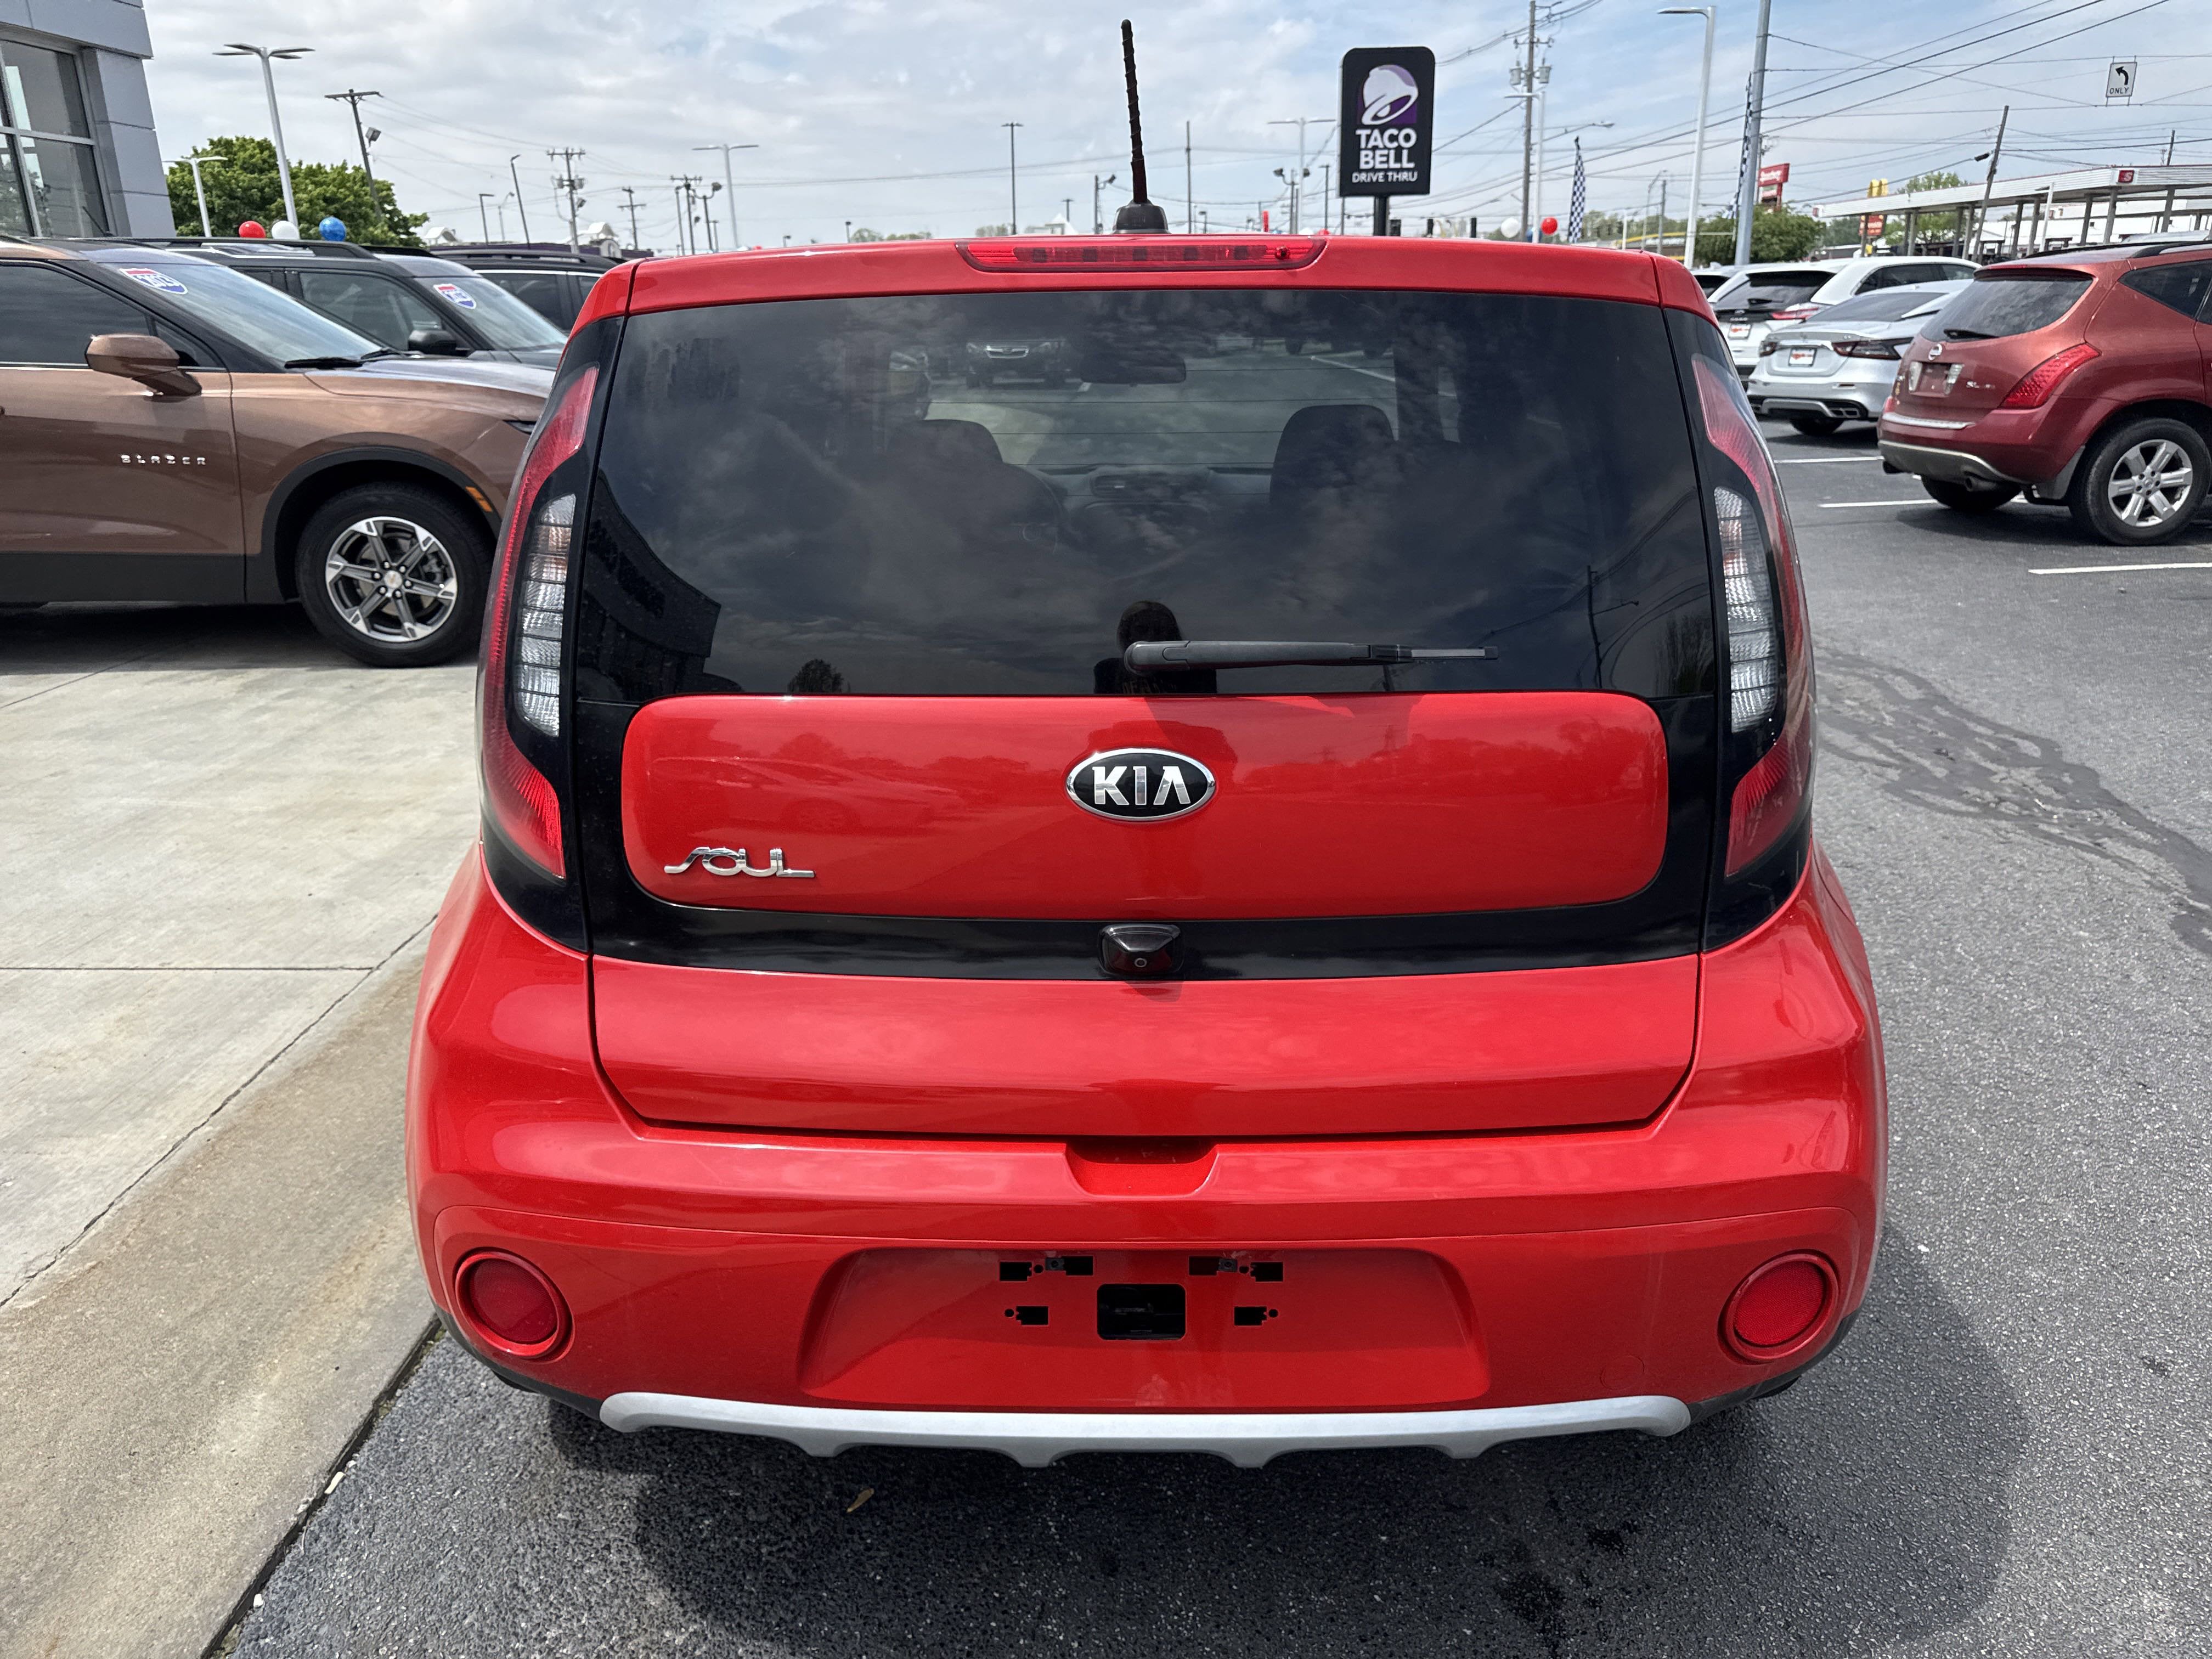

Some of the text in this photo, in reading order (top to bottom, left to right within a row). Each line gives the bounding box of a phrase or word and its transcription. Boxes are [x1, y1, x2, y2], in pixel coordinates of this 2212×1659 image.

[1356, 128, 1417, 149] TACO
[1359, 149, 1415, 170] BELL
[1352, 171, 1418, 183] DRIVE THRU
[121, 454, 206, 465] BLAZER
[1092, 766, 1191, 805] KIA
[664, 847, 815, 878] SOUL
